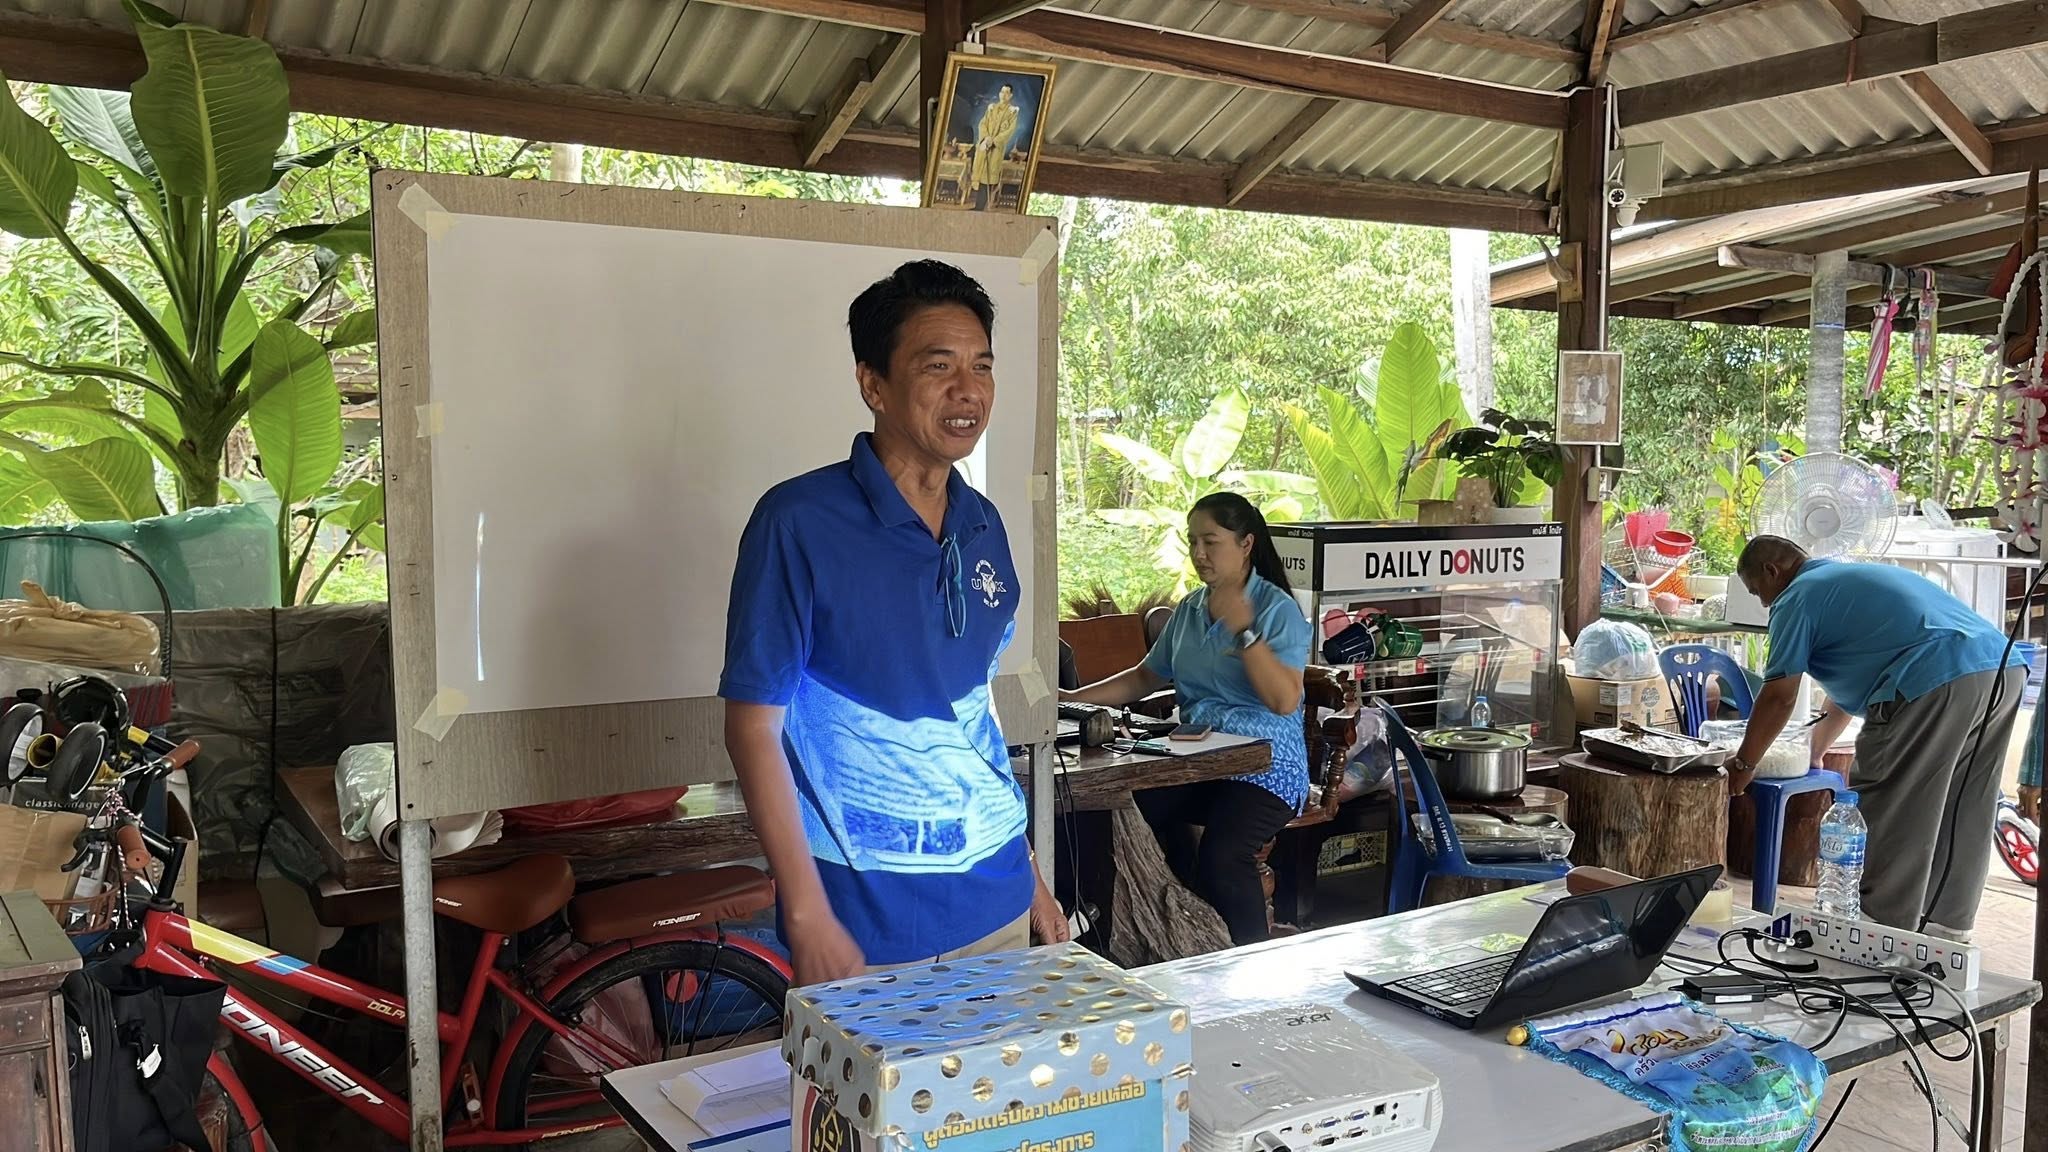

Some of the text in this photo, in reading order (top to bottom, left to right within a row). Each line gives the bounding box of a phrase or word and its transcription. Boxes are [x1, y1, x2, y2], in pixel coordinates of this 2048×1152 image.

[1365, 547, 1525, 579] DAILY DONUTS
[652, 912, 702, 928] PIONEER
[1285, 1011, 1333, 1027] acer
